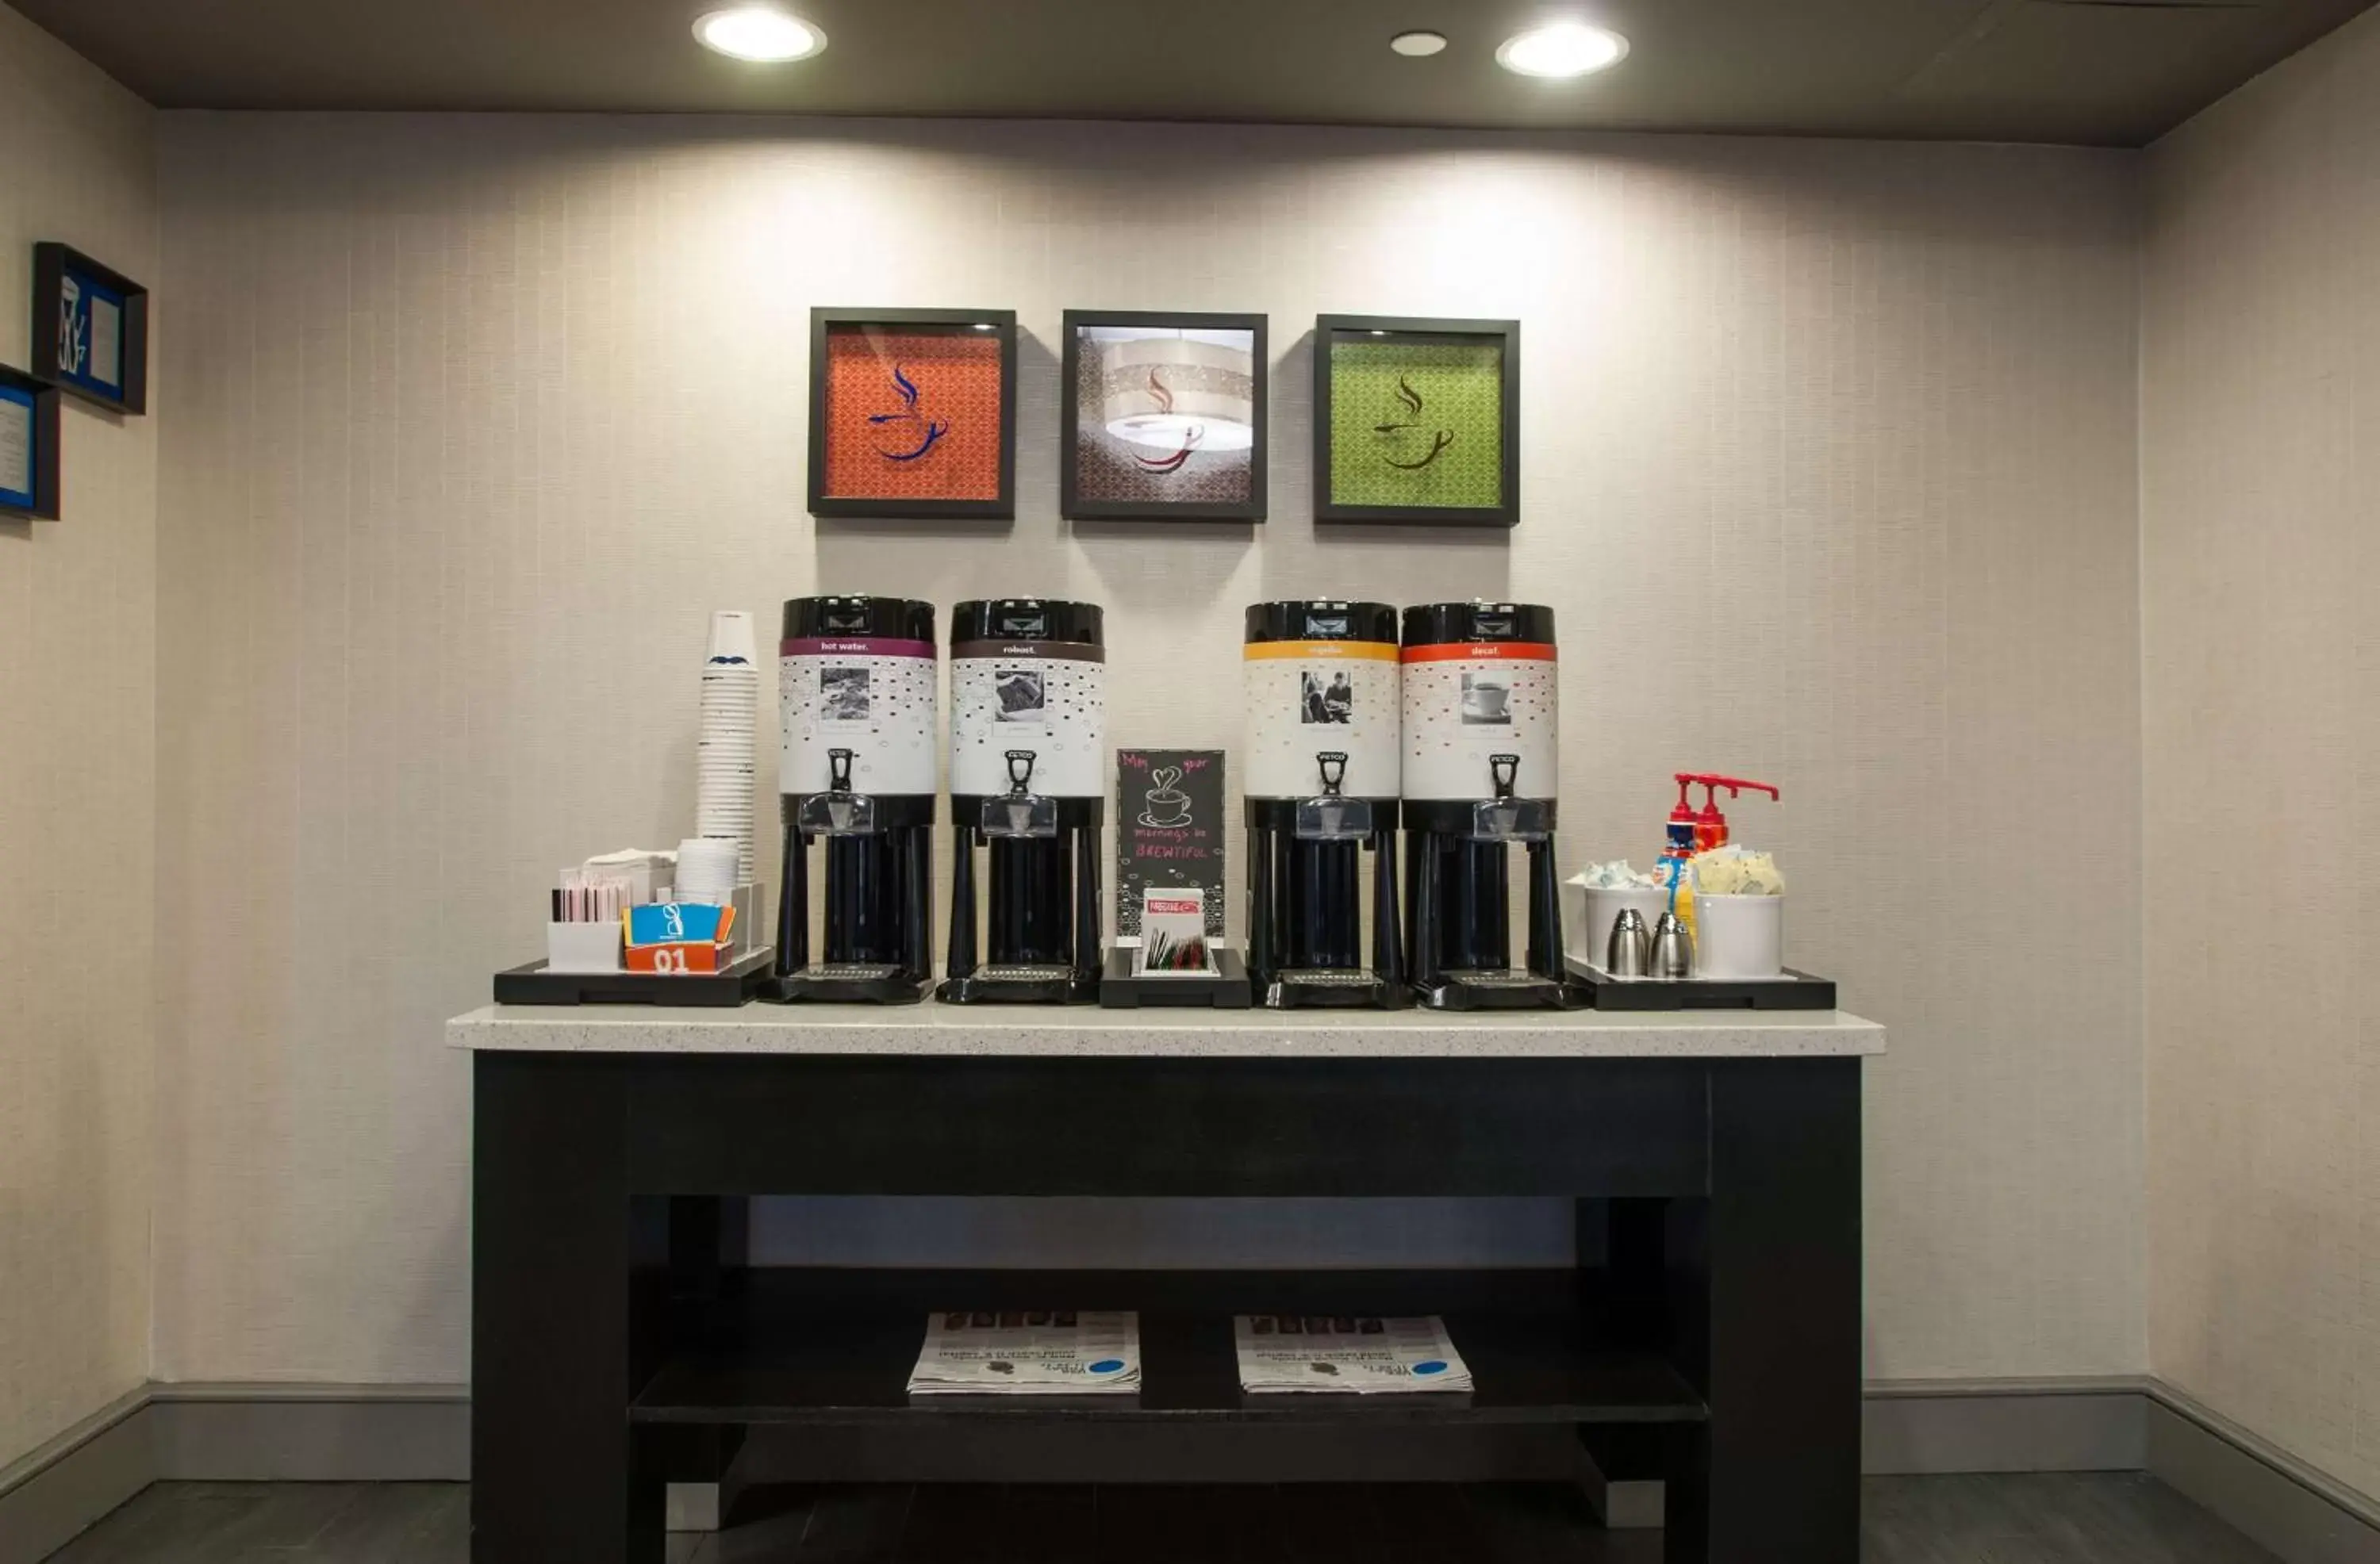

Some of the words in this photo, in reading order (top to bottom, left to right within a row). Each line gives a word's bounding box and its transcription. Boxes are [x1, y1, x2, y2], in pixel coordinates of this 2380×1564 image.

[821, 641, 837, 650] hot
[1182, 758, 1210, 774] your
[1133, 827, 1188, 842] mornings
[1135, 843, 1207, 858] BREWTIFUL
